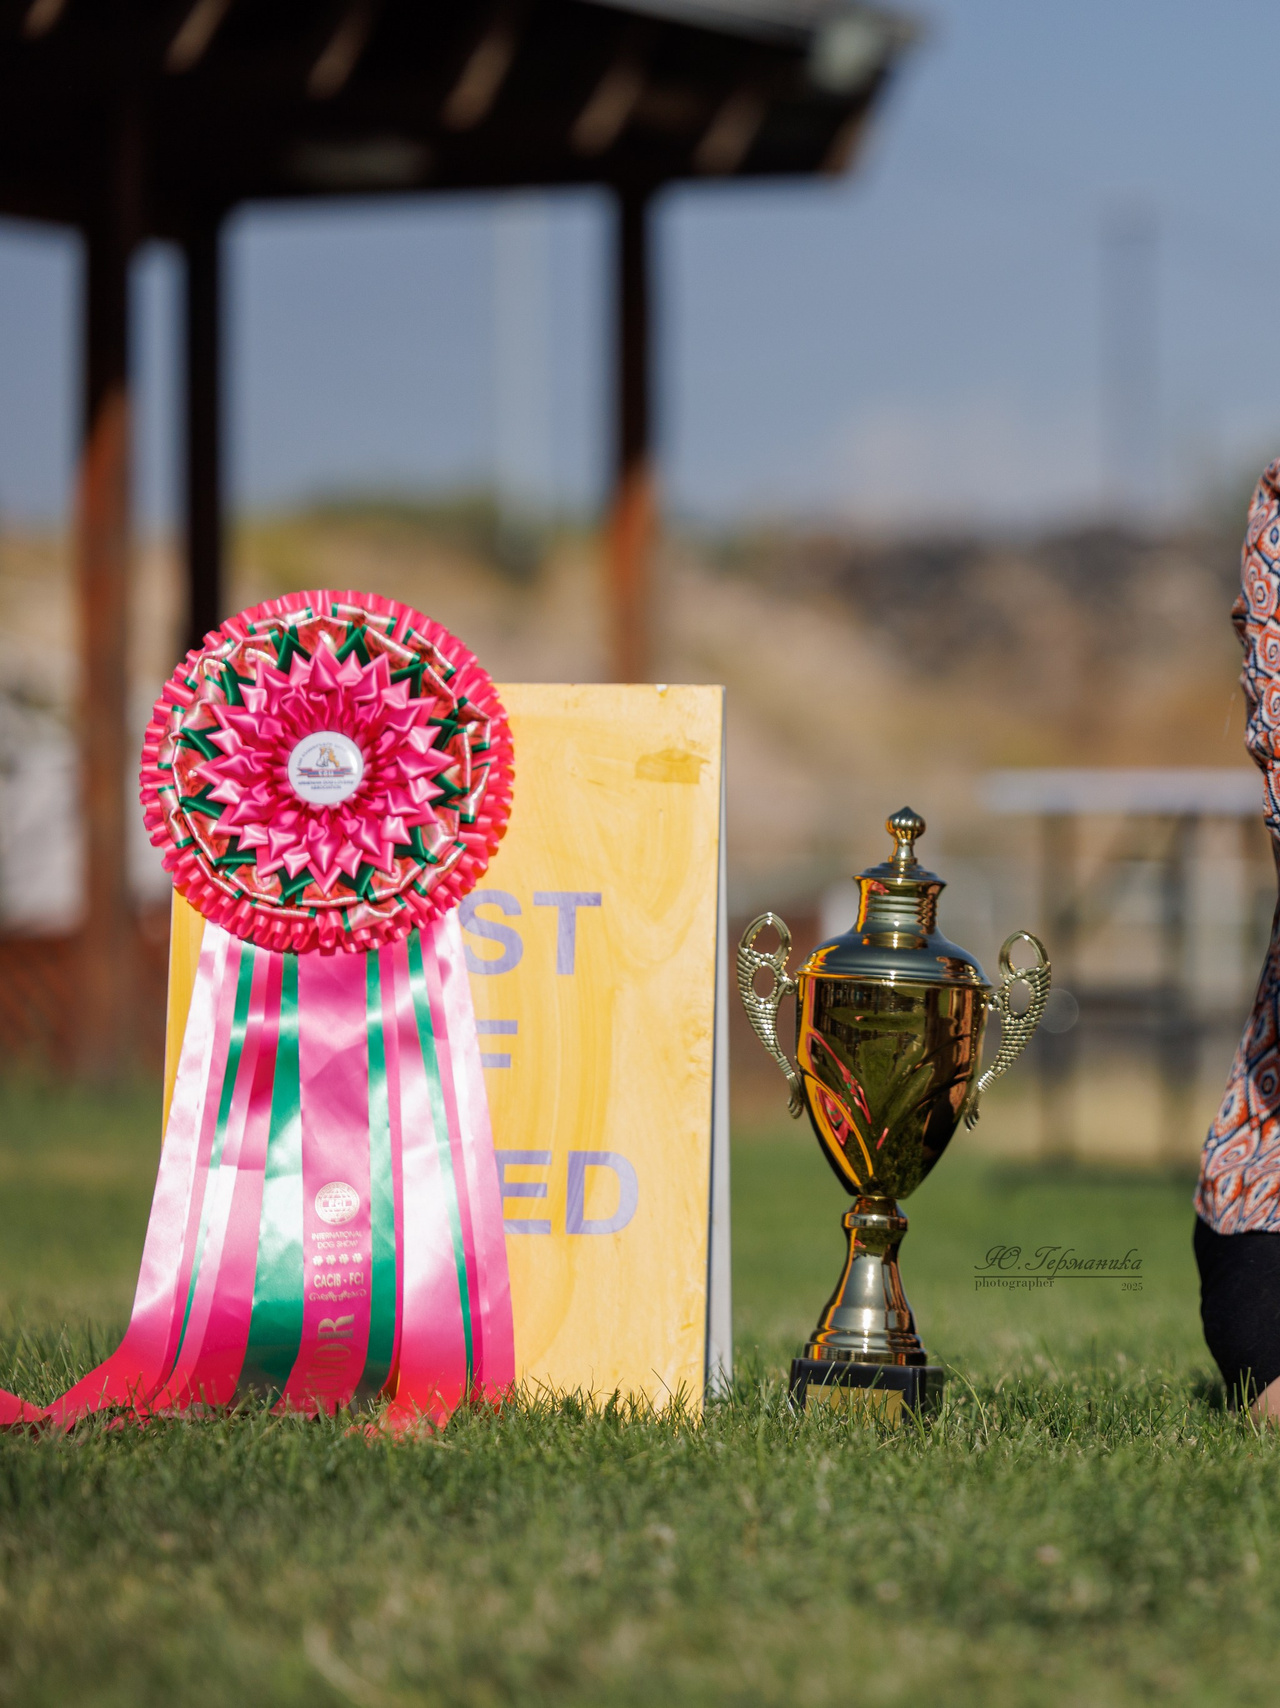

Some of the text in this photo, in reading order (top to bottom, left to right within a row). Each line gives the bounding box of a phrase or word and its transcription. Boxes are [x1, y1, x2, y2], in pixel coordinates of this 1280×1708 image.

[457, 888, 602, 975] ST
[311, 1230, 362, 1240] INTERNATIONAL
[317, 1239, 359, 1249] DOG SHOW
[313, 1272, 342, 1289] CACIB
[349, 1271, 364, 1287] FCI
